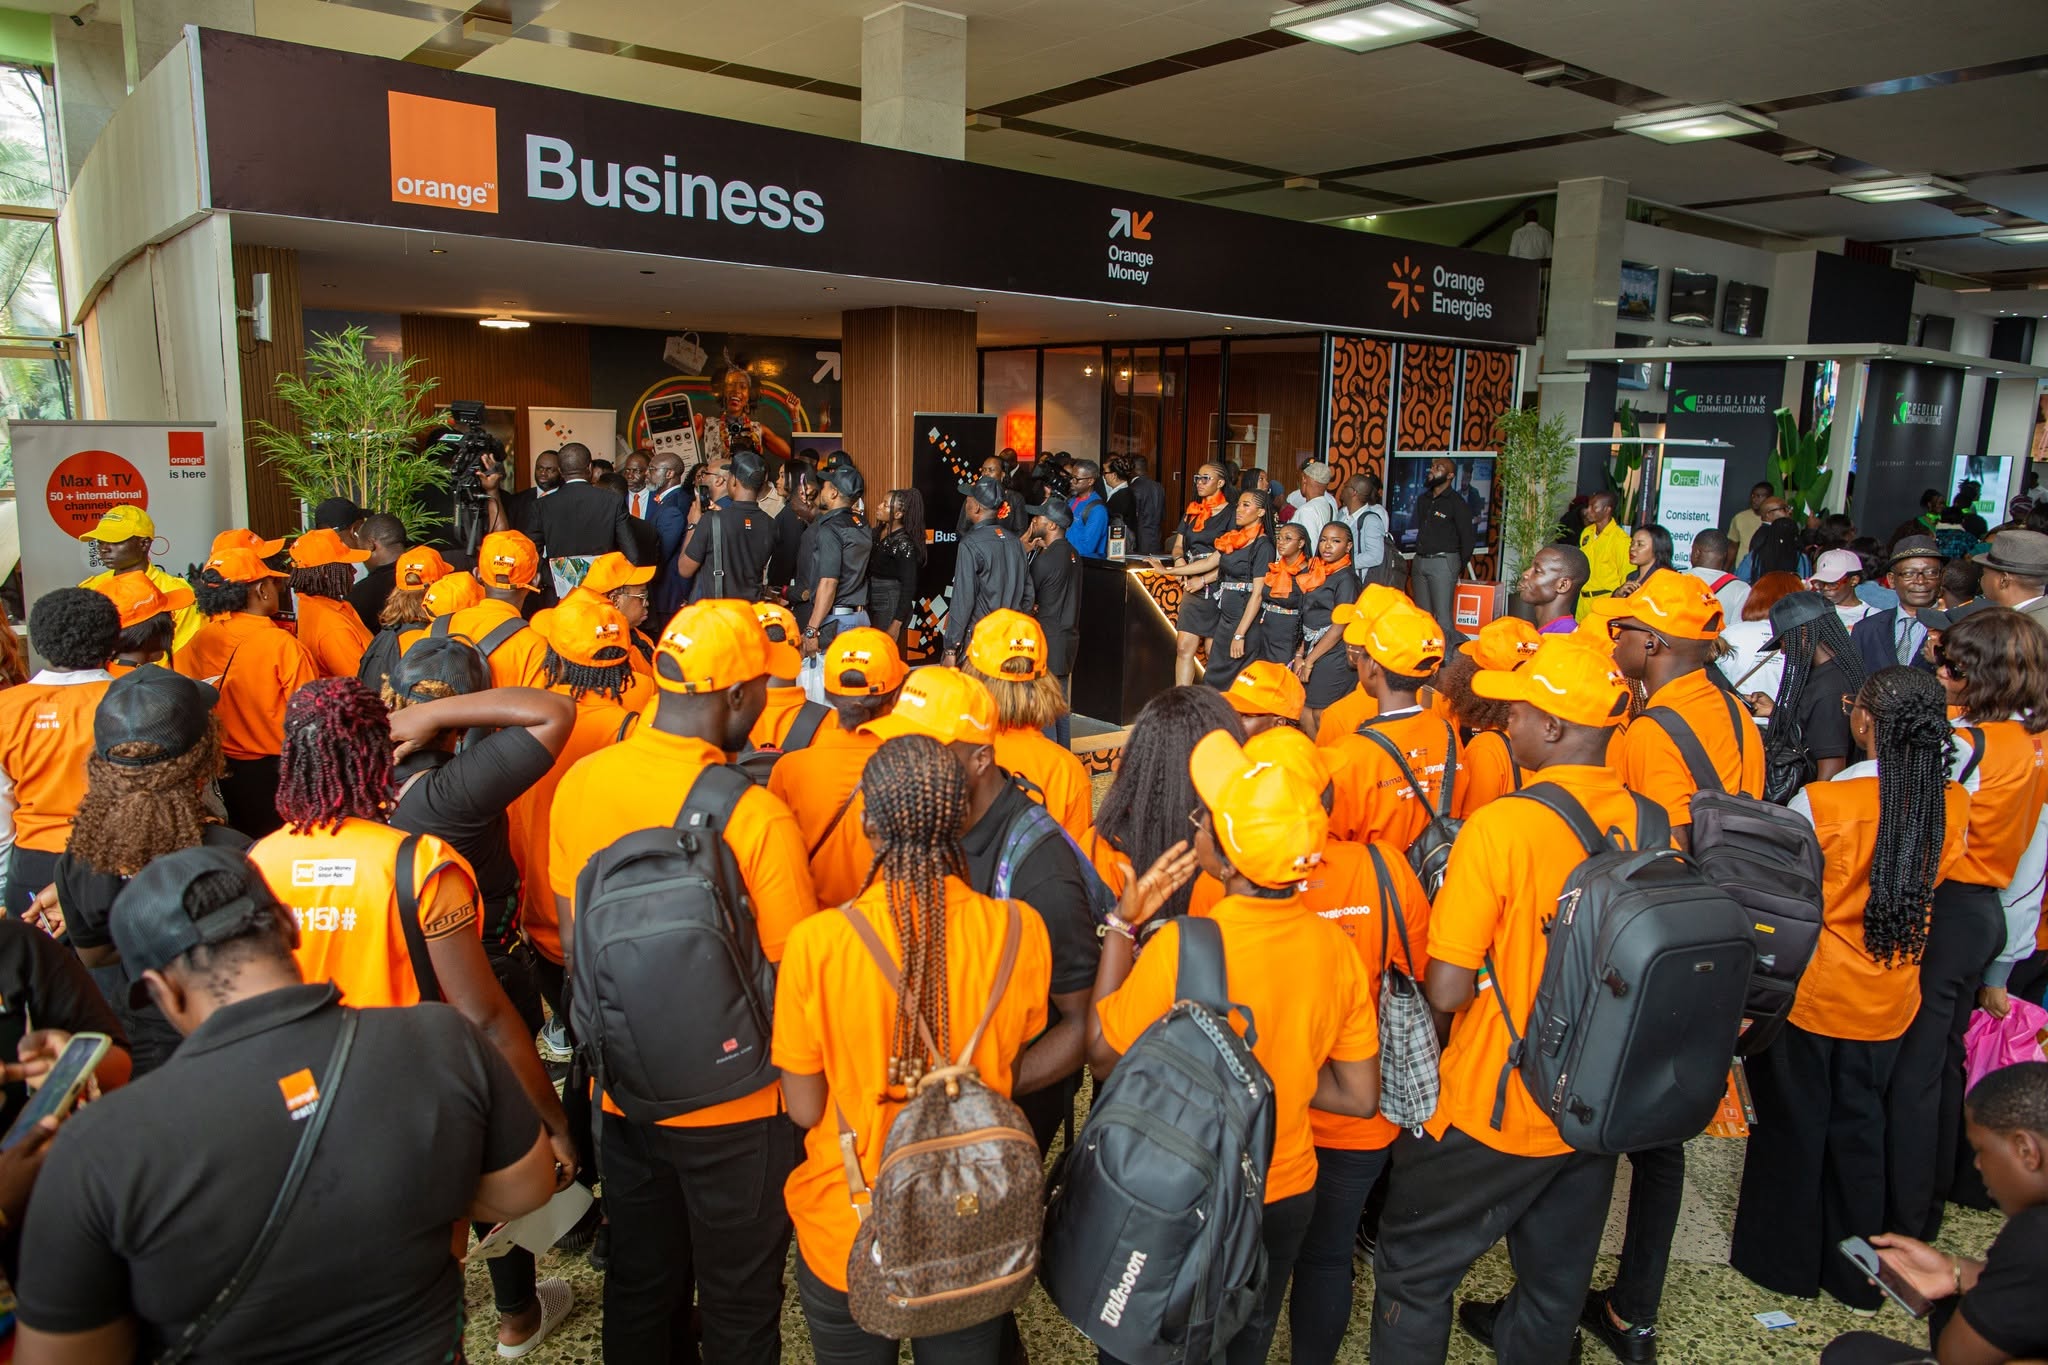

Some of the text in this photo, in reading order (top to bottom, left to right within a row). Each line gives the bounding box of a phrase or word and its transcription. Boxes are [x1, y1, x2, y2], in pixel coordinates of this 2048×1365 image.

[526, 133, 825, 233] Business
[1108, 244, 1154, 268] Orange
[1108, 262, 1149, 285] Money
[1433, 265, 1485, 296] Orange
[1432, 291, 1492, 321] Energies
[1696, 404, 1765, 414] COMMUNICATIONS
[169, 469, 207, 479] is here
[60, 474, 133, 487] Max it TV
[50, 490, 142, 501] 50 + international
[64, 501, 113, 511] channels
[72, 511, 88, 523] my
[1665, 510, 1711, 522] Consistent,
[935, 530, 957, 542] Bus
[1671, 531, 1694, 544] eedy
